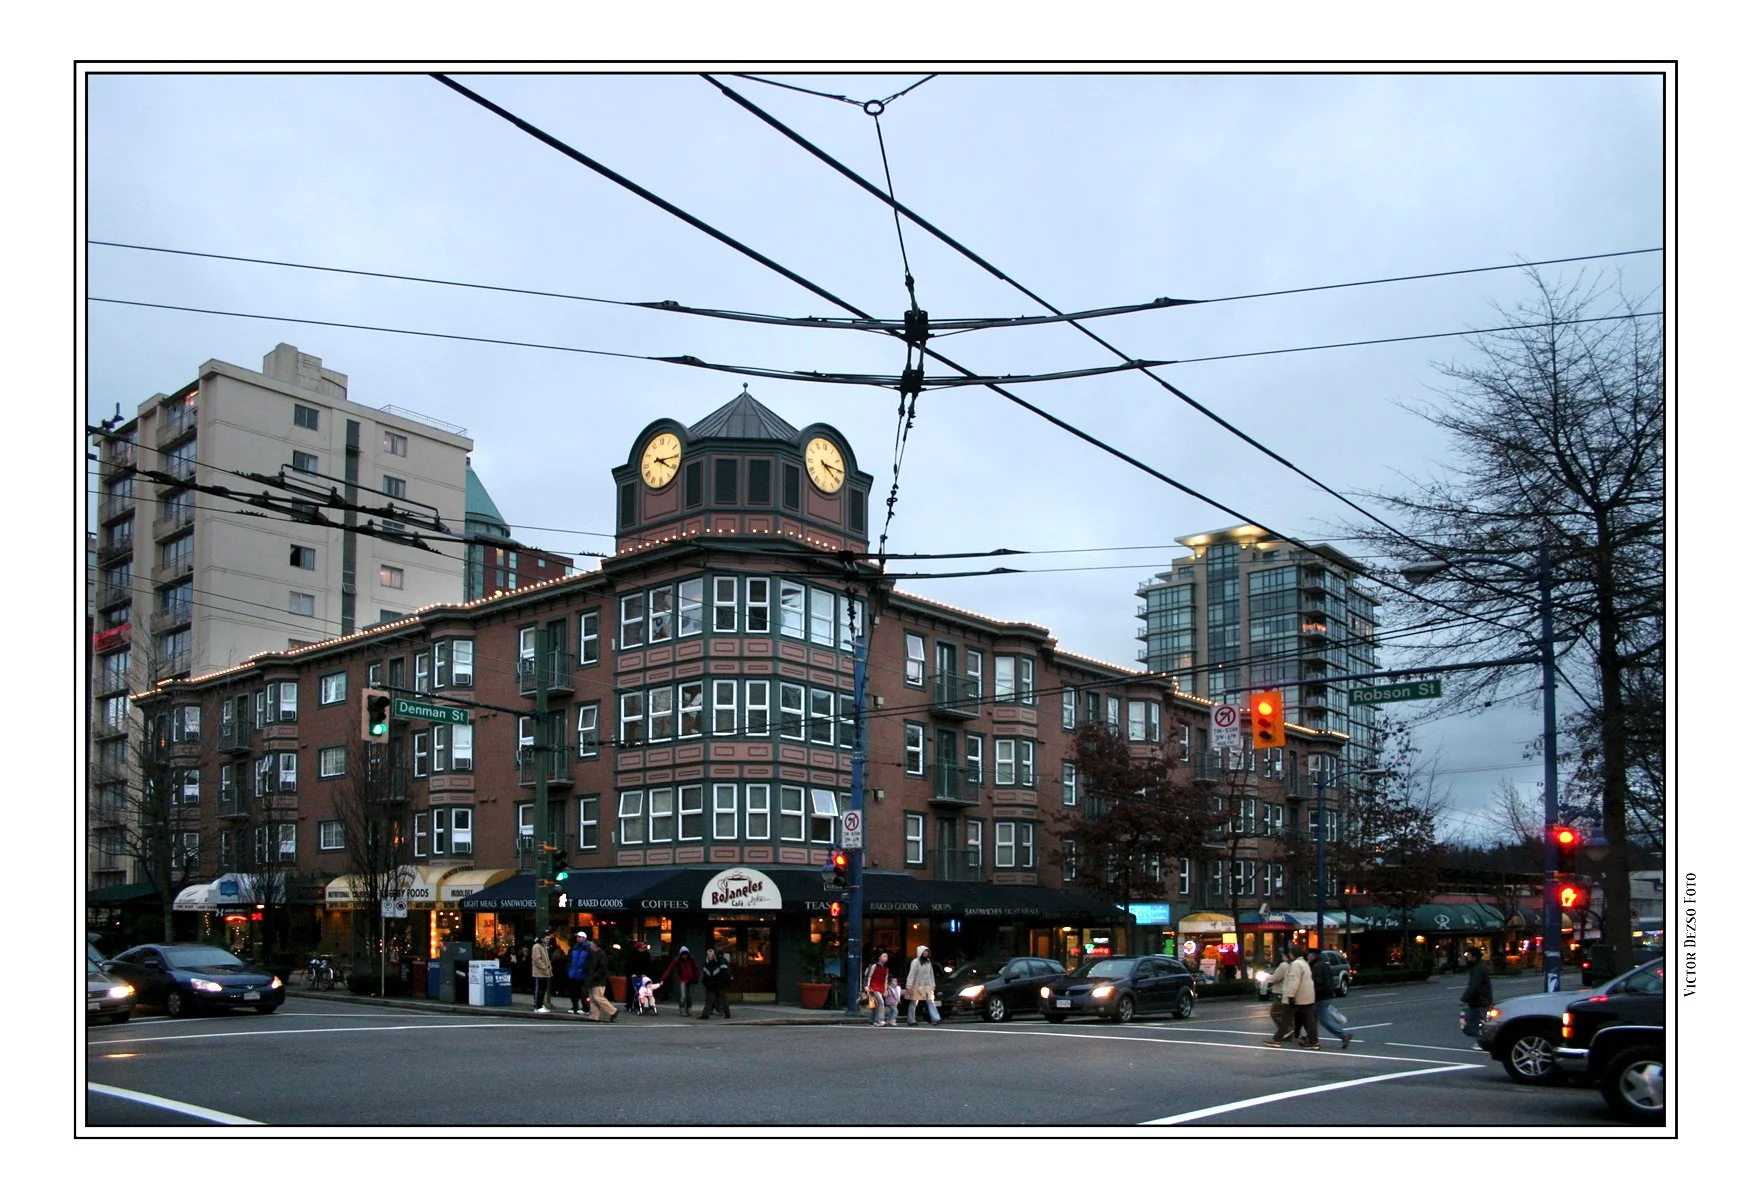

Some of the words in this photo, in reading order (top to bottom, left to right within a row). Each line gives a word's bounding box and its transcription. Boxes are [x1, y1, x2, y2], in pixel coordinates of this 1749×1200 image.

[1353, 687, 1411, 702] Robson
[1418, 683, 1435, 696] St
[400, 702, 446, 718] Denman
[452, 710, 464, 721] St
[407, 888, 429, 898] FOODS
[463, 900, 479, 908] LIGHT
[480, 900, 498, 908] MEALS
[500, 899, 537, 908] SANDWICHES
[577, 899, 599, 908] BAKED
[599, 899, 623, 908] GOODS
[641, 900, 689, 909] COFFEES
[804, 901, 831, 910] TEAS
[870, 902, 894, 911] BAKED
[894, 902, 919, 911] GOODS
